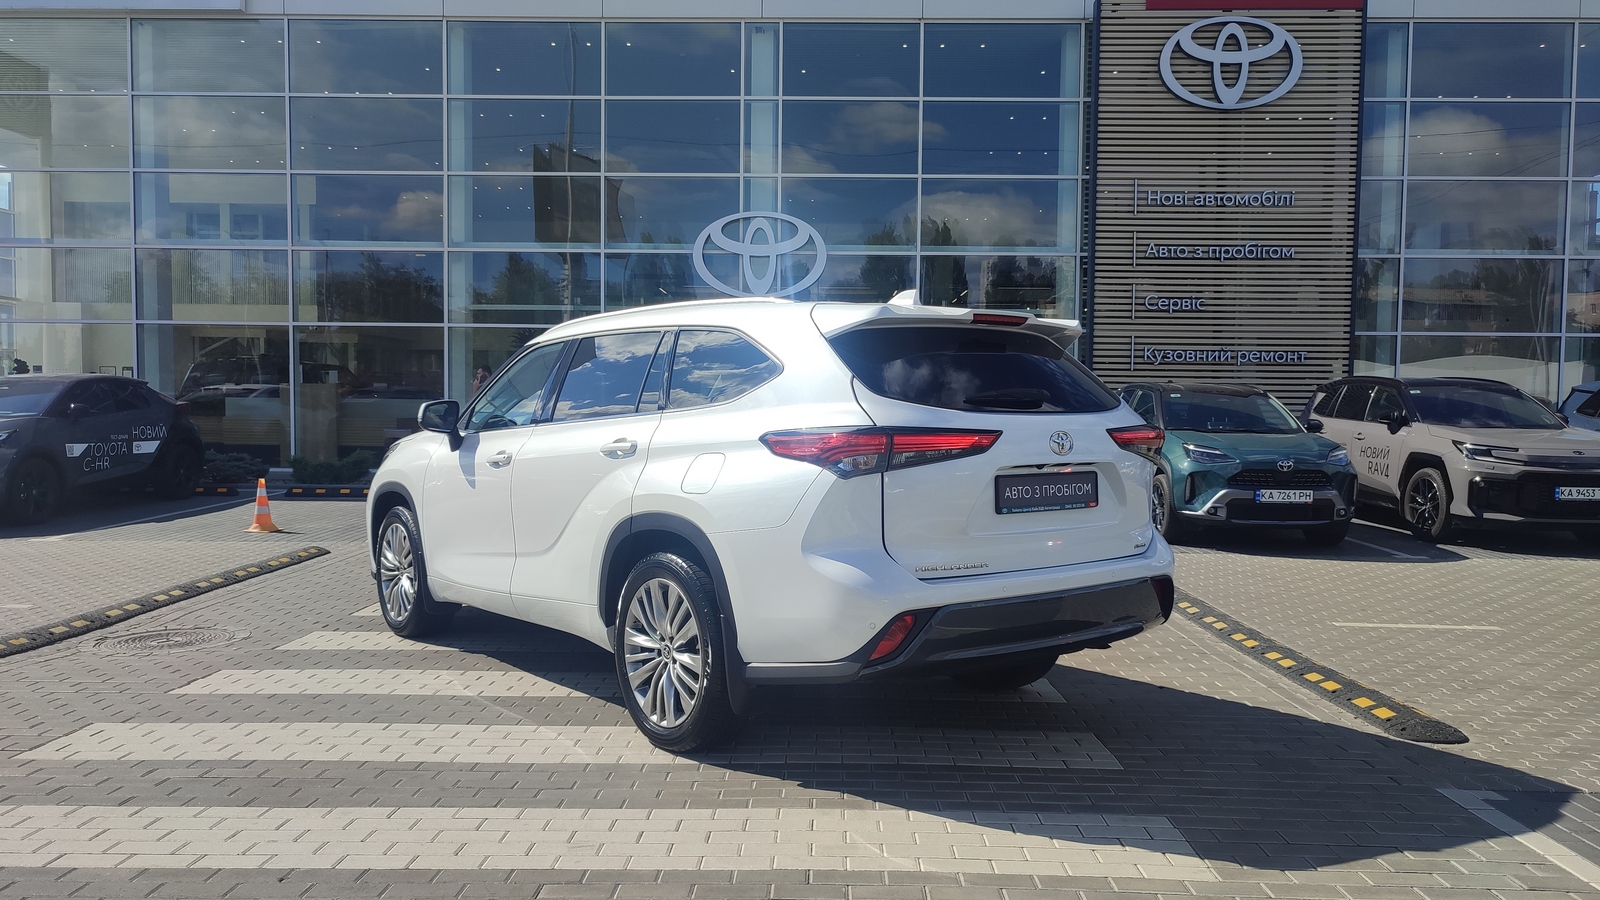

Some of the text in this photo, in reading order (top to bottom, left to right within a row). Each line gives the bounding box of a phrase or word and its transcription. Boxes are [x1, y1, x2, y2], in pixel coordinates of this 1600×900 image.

[1146, 190, 1296, 206] Нові автомобілі
[1145, 242, 1295, 262] Авто з пробігом
[1144, 294, 1206, 313] Сервіс
[1143, 346, 1307, 366] Кузовний ремонт
[132, 423, 167, 439] НОВИЙ
[90, 442, 128, 456] TOYOTA
[1360, 446, 1390, 460] НОВИЙ
[83, 457, 110, 471] C-HR
[1368, 461, 1389, 479] RAV4
[1005, 486, 1031, 499] АВТО
[1043, 483, 1092, 497] ПРОБІГОМ
[1261, 491, 1312, 501] KA 7261 PH
[1560, 489, 1596, 498] KA 9453
[915, 562, 989, 572] HIGHLANDER
